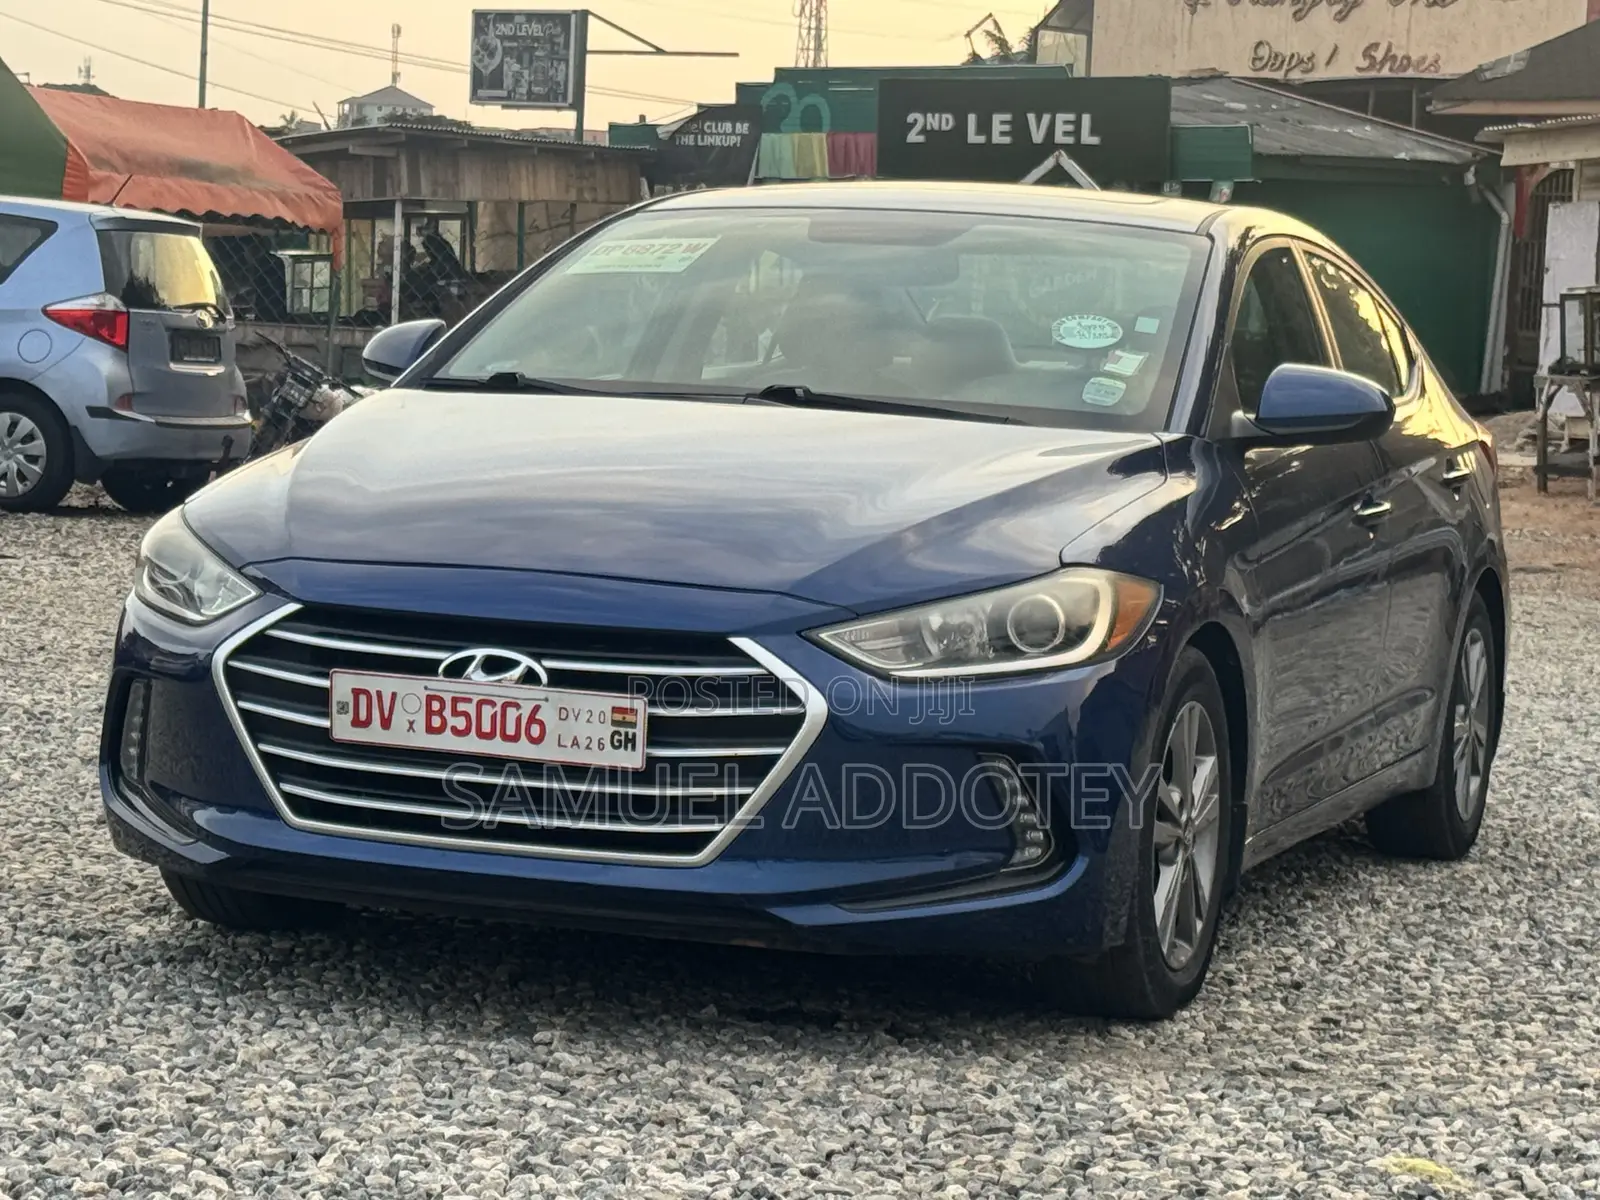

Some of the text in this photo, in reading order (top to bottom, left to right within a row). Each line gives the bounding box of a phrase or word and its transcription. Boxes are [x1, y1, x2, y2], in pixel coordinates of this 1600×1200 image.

[495, 23, 515, 36] 2ND
[516, 21, 544, 37] LEVEL
[703, 120, 733, 134] CLUB
[734, 121, 750, 135] BE
[906, 112, 956, 143] 2ND
[675, 133, 742, 148] THE LINKUP!
[350, 687, 397, 731] DV
[425, 693, 548, 745] B5006
[610, 730, 637, 752] GH
